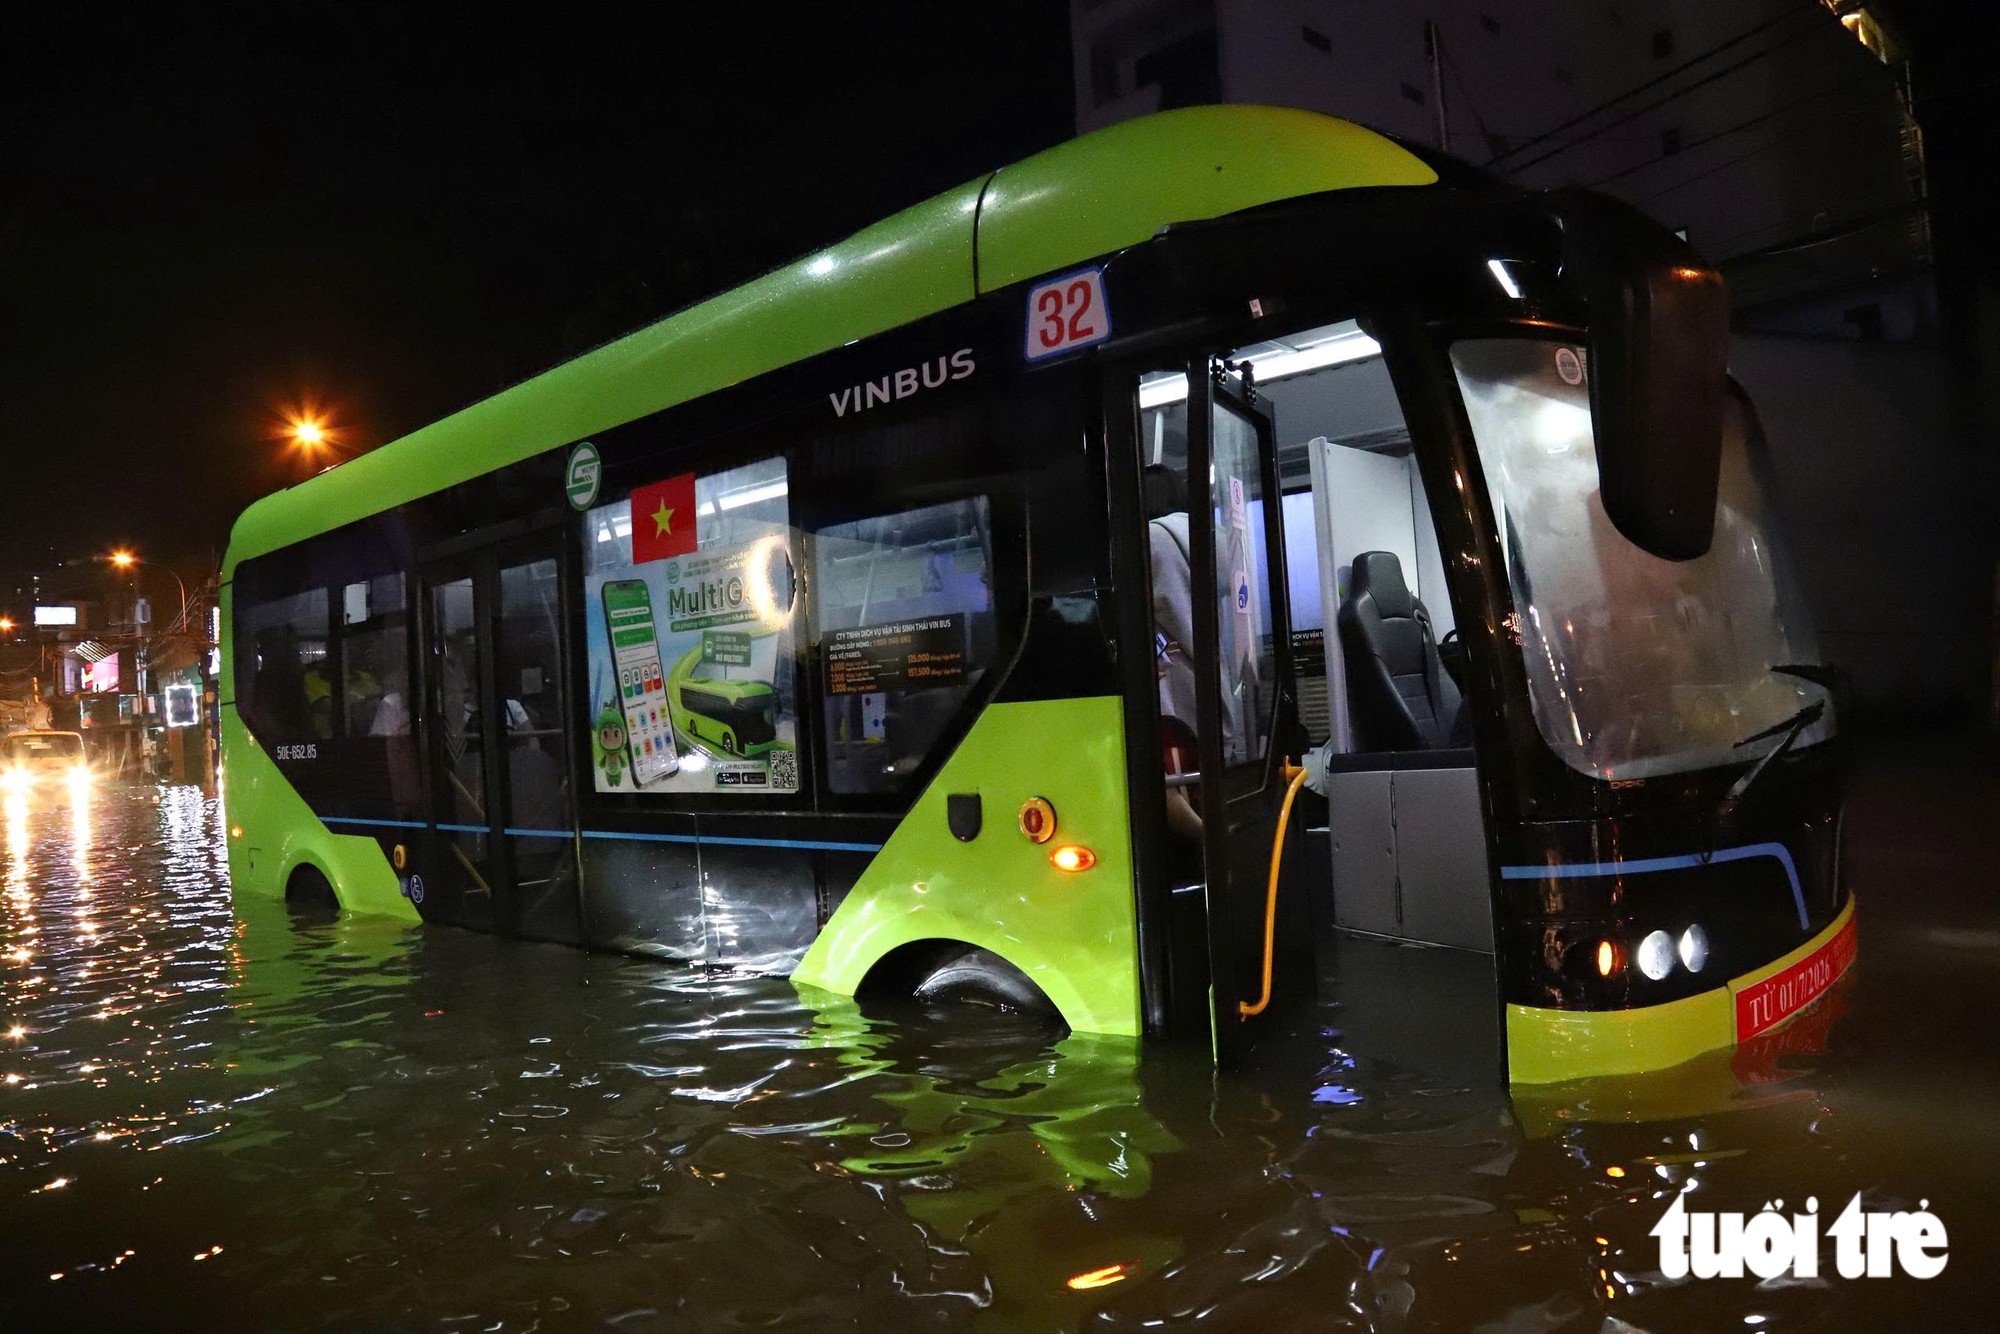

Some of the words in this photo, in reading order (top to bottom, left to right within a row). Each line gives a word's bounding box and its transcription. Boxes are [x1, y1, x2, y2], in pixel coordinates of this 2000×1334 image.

[1037, 279, 1094, 349] 32
[829, 348, 976, 418] VINBUS
[860, 630, 873, 639] DỊCH
[874, 629, 881, 637] VỤ
[881, 626, 893, 636] VẬN
[902, 624, 915, 632] SINH
[915, 621, 928, 631] THÁI
[929, 621, 939, 629] VIN
[939, 619, 951, 628] BUS
[907, 667, 931, 677] 157.500
[276, 744, 317, 760] 50E-652.85
[1750, 983, 1776, 1028] TỪ
[1779, 954, 1831, 1013] 01/7/2026
